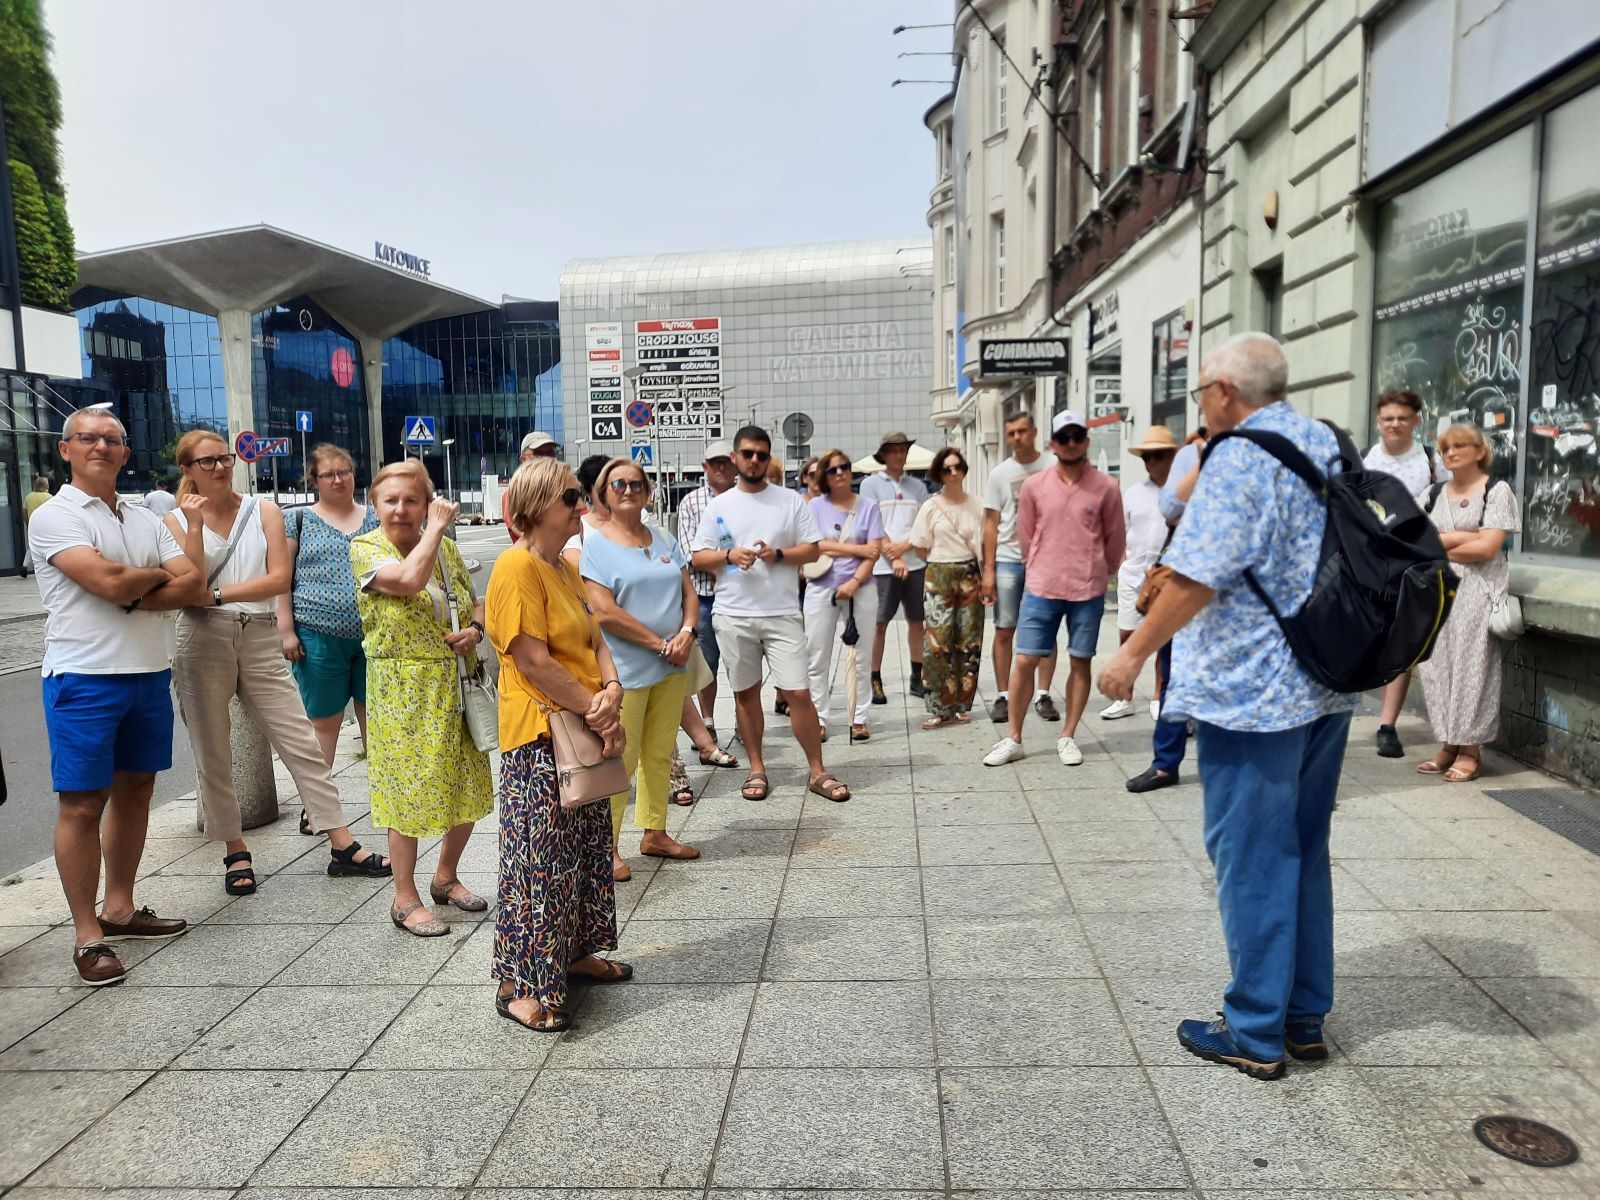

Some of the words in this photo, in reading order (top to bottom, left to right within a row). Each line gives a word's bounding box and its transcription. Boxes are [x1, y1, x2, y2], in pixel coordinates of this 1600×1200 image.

[375, 240, 431, 276] KATOWICE
[638, 333, 676, 346] CROPP
[789, 321, 905, 353] GALERIA
[983, 341, 1066, 360] COMMANDO
[591, 391, 621, 400] DOUGLAS
[597, 405, 614, 413] CCC
[595, 421, 618, 437] C&A
[256, 440, 287, 454] TAXI
